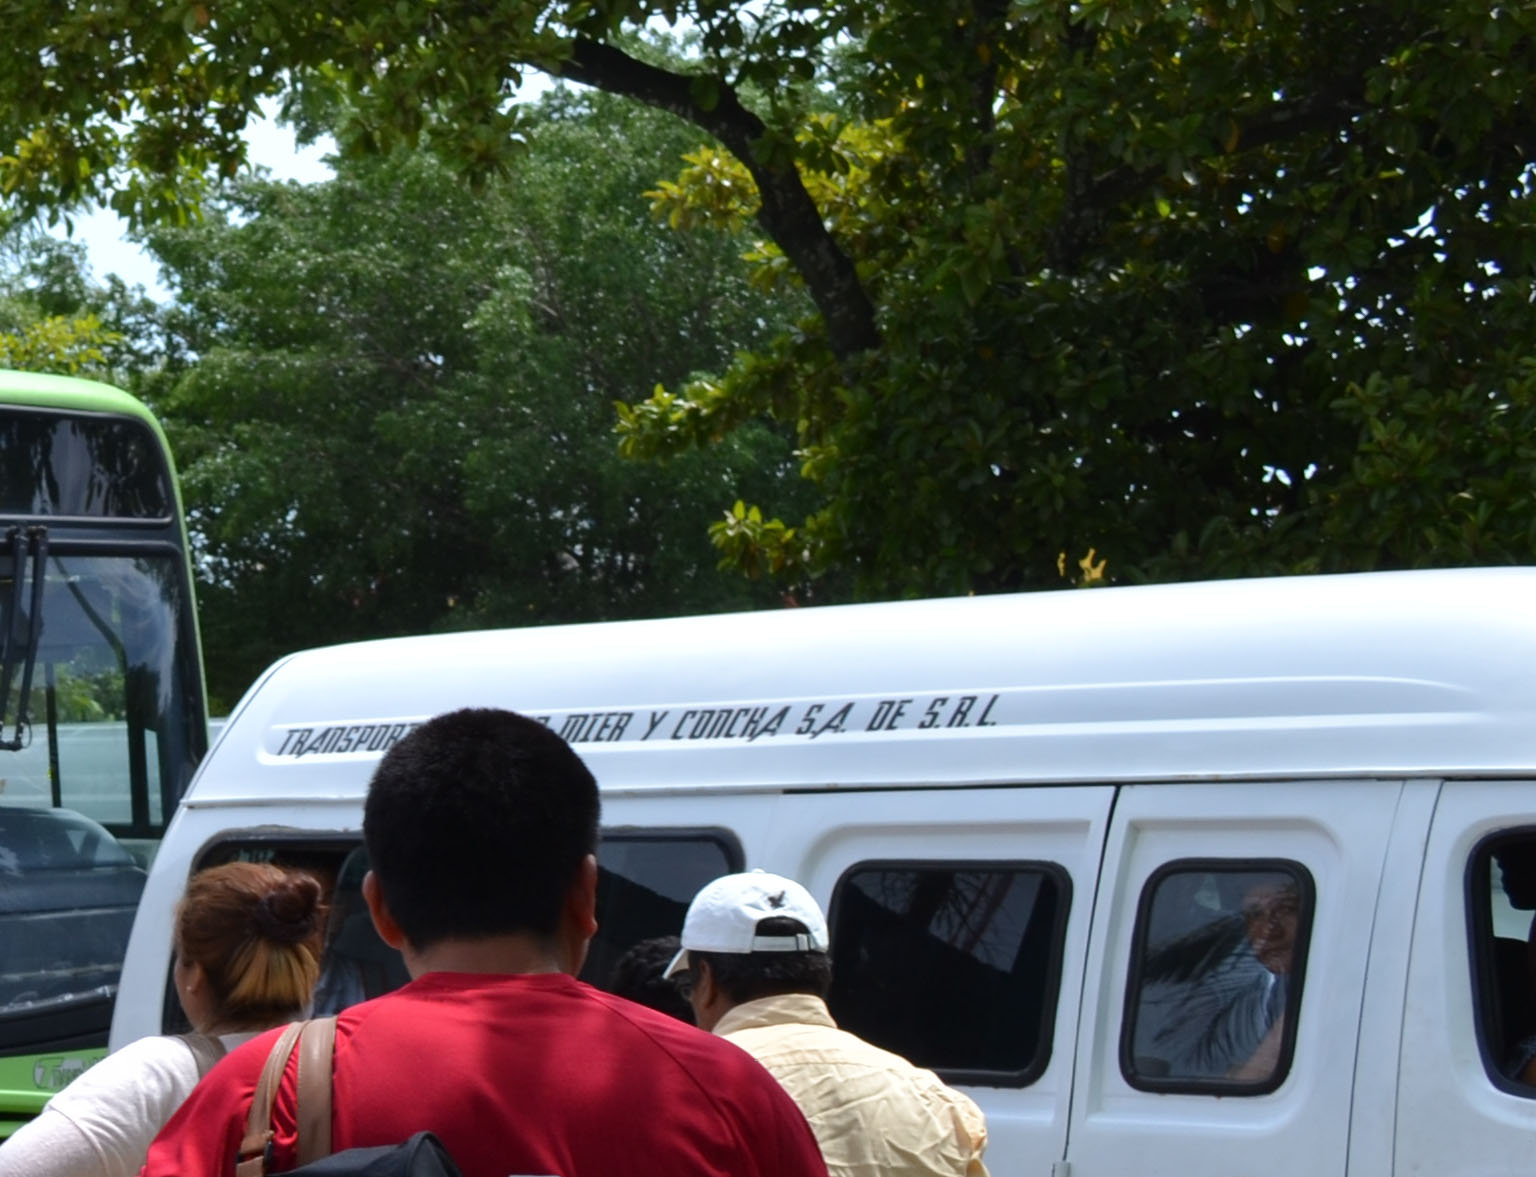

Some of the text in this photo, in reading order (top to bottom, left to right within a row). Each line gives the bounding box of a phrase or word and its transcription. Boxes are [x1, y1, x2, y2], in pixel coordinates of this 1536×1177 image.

[559, 712, 634, 743] MIER
[640, 710, 669, 741] Y
[670, 705, 791, 742] CONCHA
[866, 699, 913, 732] DE
[918, 694, 1000, 730] S.R.L.
